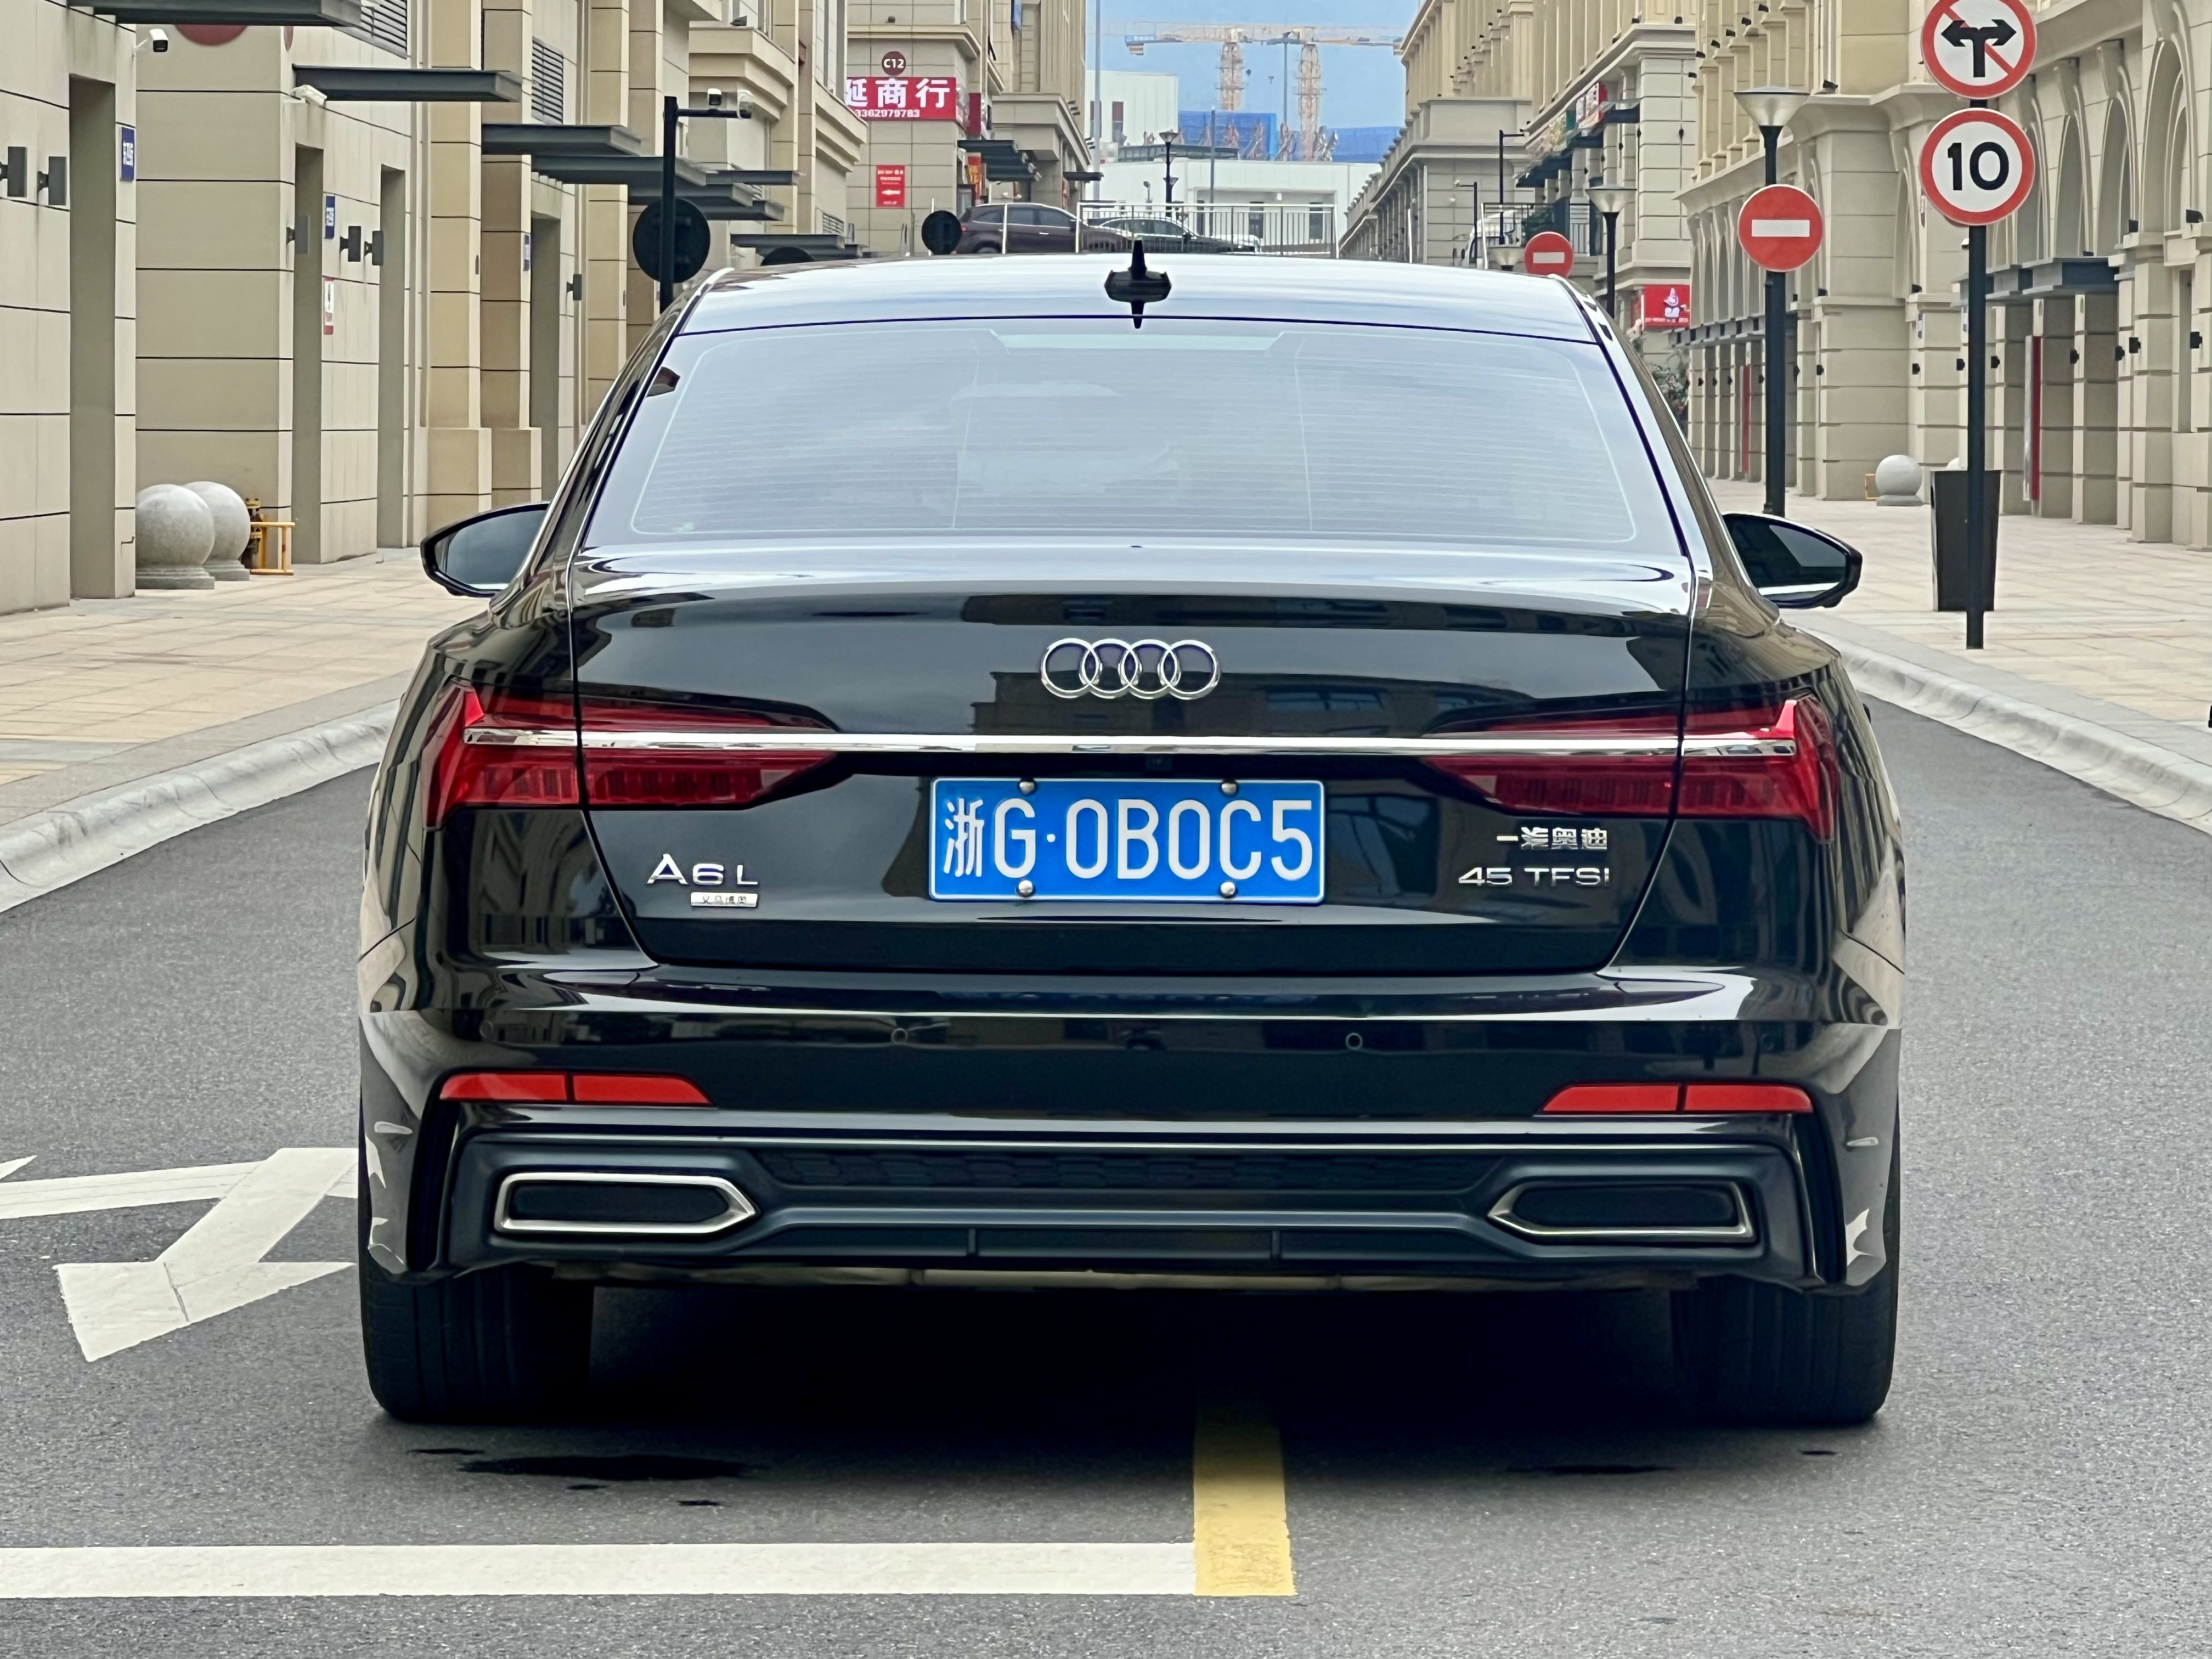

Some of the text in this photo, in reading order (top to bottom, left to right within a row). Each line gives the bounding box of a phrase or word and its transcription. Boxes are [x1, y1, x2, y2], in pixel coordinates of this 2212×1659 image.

[883, 59, 904, 68] C12
[1948, 142, 2009, 190] 10
[1497, 827, 1607, 850] 一汽奥迪
[1459, 867, 1610, 886] 45 TFSI
